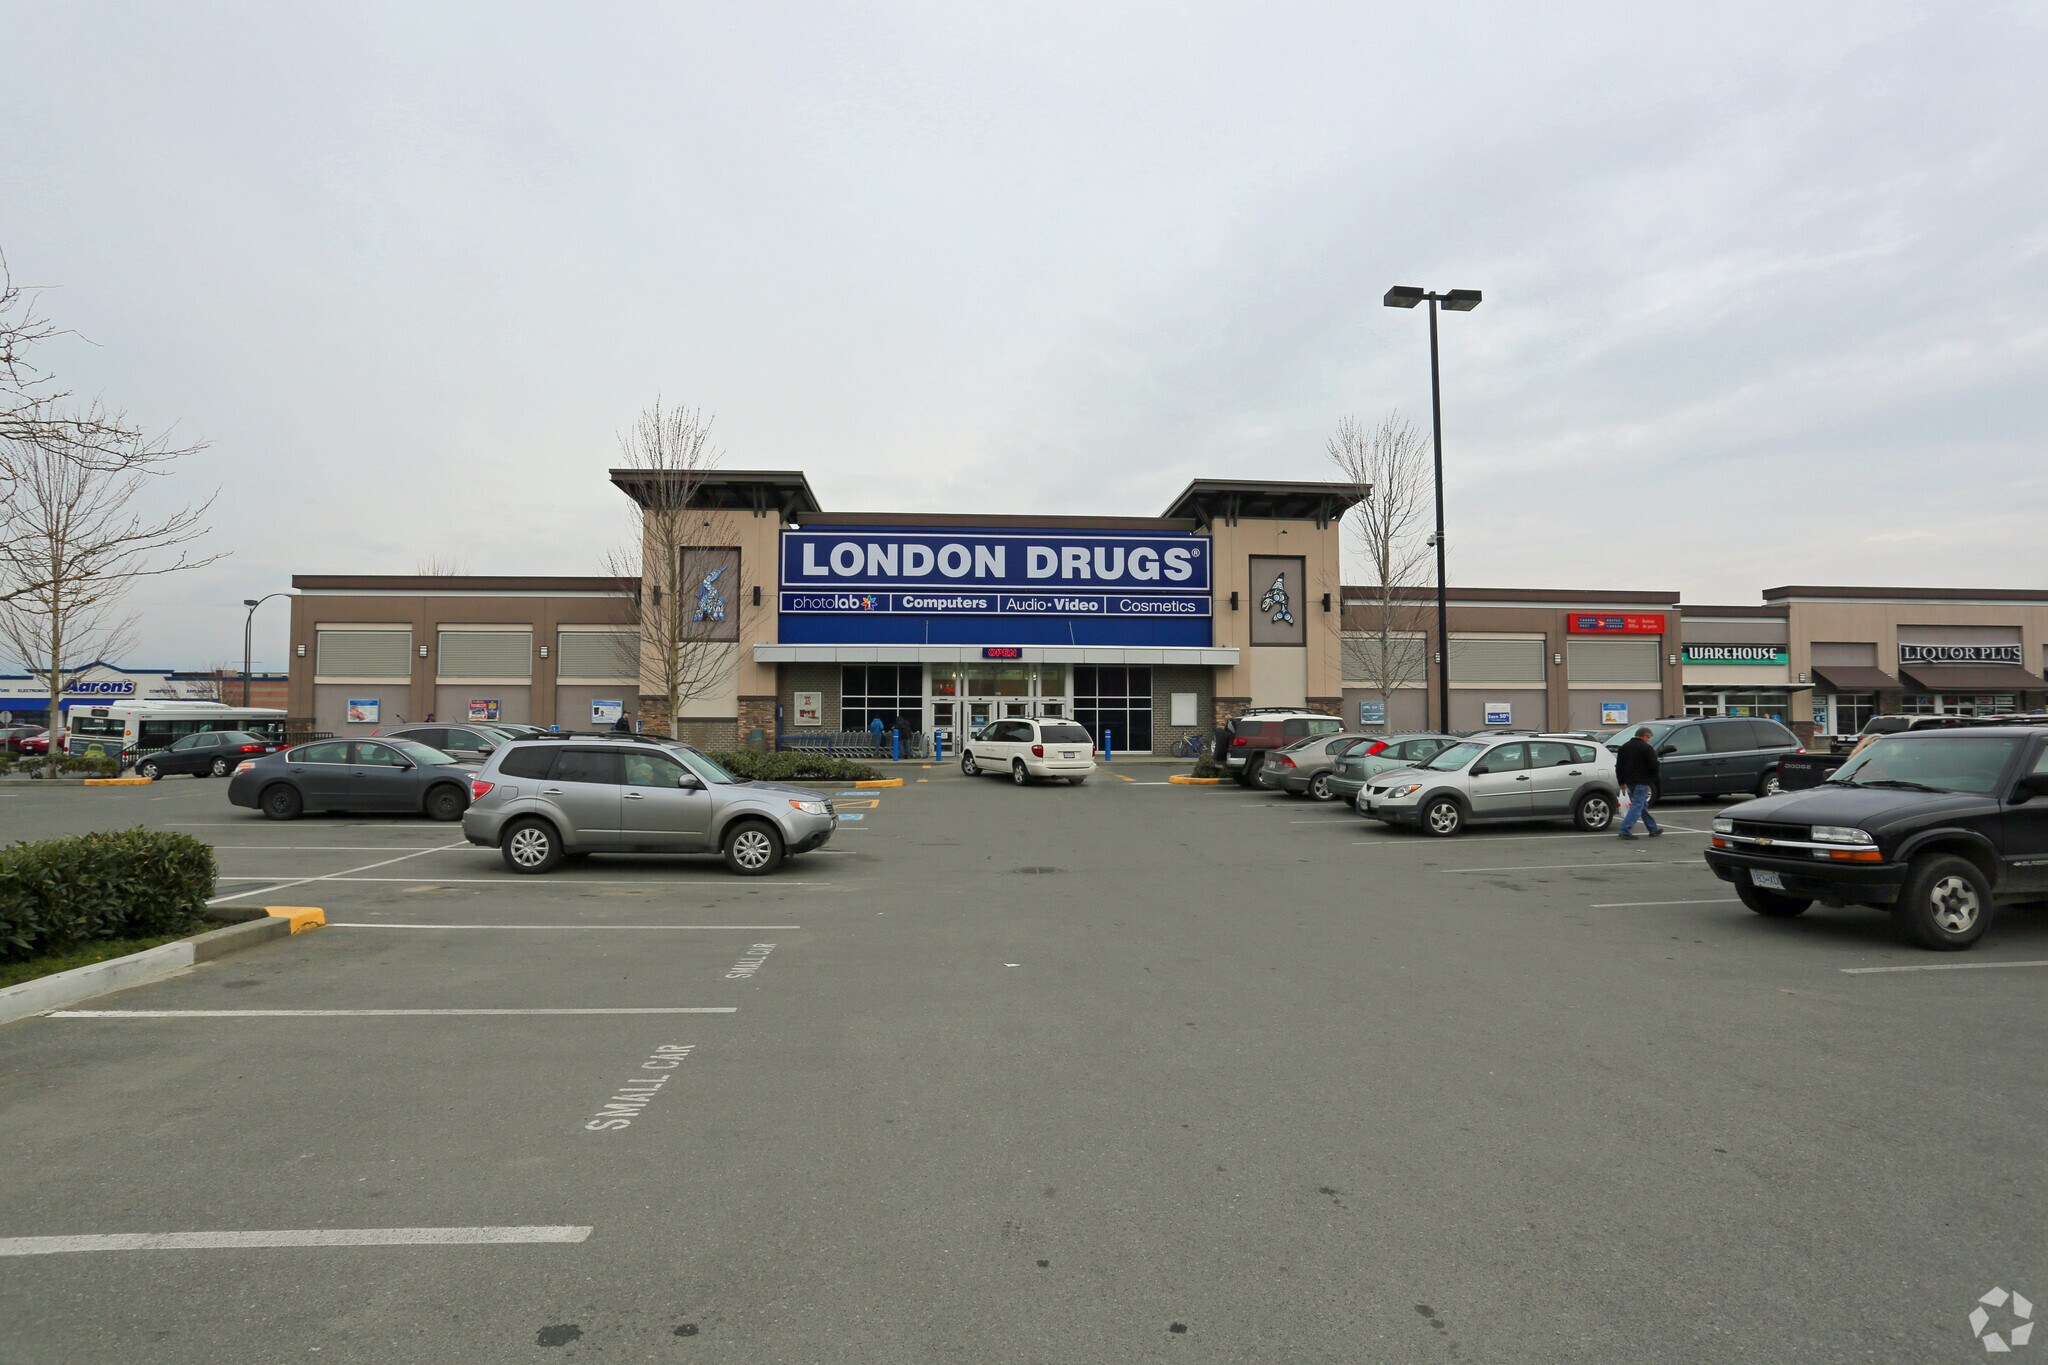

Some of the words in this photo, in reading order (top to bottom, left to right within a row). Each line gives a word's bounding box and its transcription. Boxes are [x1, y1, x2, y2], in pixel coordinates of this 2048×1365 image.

[803, 542, 1005, 577] LONDON
[793, 595, 860, 610] photolab
[902, 596, 988, 610] Computers
[1120, 599, 1196, 612] Cosmetics
[988, 648, 1017, 657] OPEN
[1689, 647, 1778, 660] WAREHOUSE
[1904, 647, 1976, 663] LIQUOR
[1980, 647, 2021, 660] PLUS
[62, 679, 135, 694] Aaron's
[585, 1074, 670, 1131] SMALL
[641, 1044, 696, 1070] CAR
